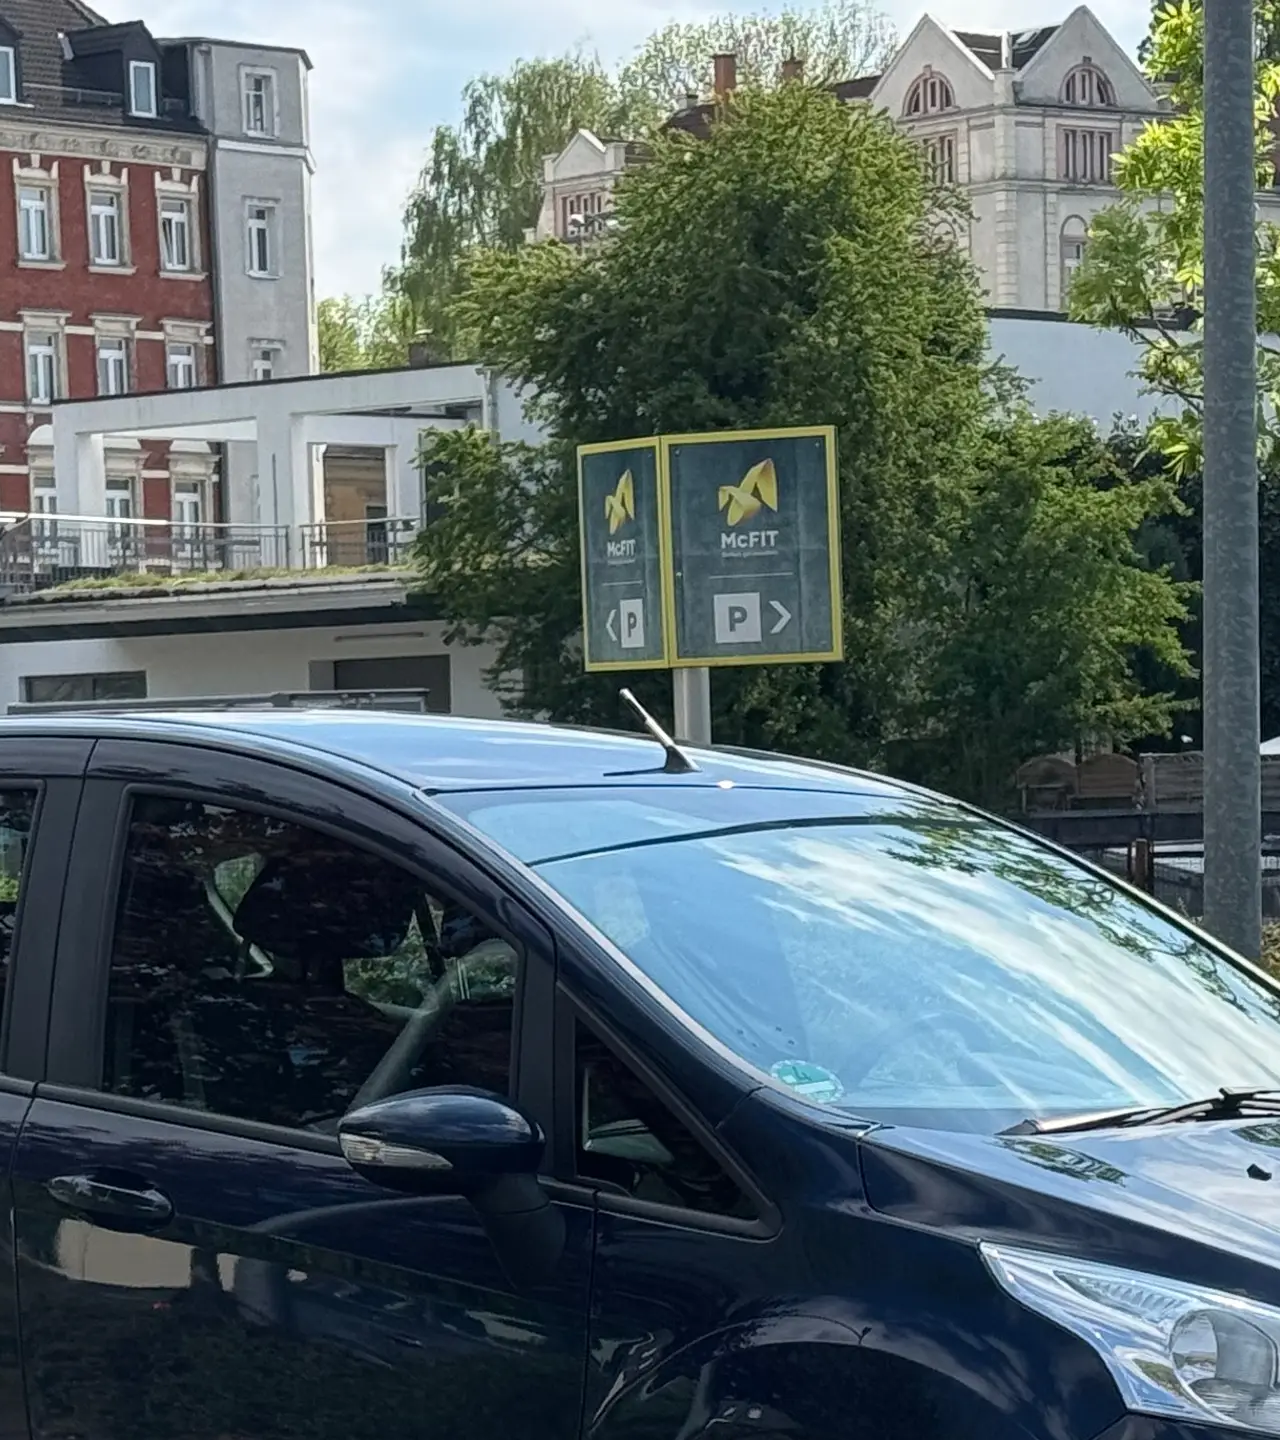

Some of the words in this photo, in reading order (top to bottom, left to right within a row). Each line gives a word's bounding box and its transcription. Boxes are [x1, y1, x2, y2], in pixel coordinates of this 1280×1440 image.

[607, 539, 636, 557] McFIT
[720, 530, 779, 549] McFIT
[627, 612, 637, 638] P
[728, 606, 748, 632] P
[791, 1065, 813, 1081] 4
